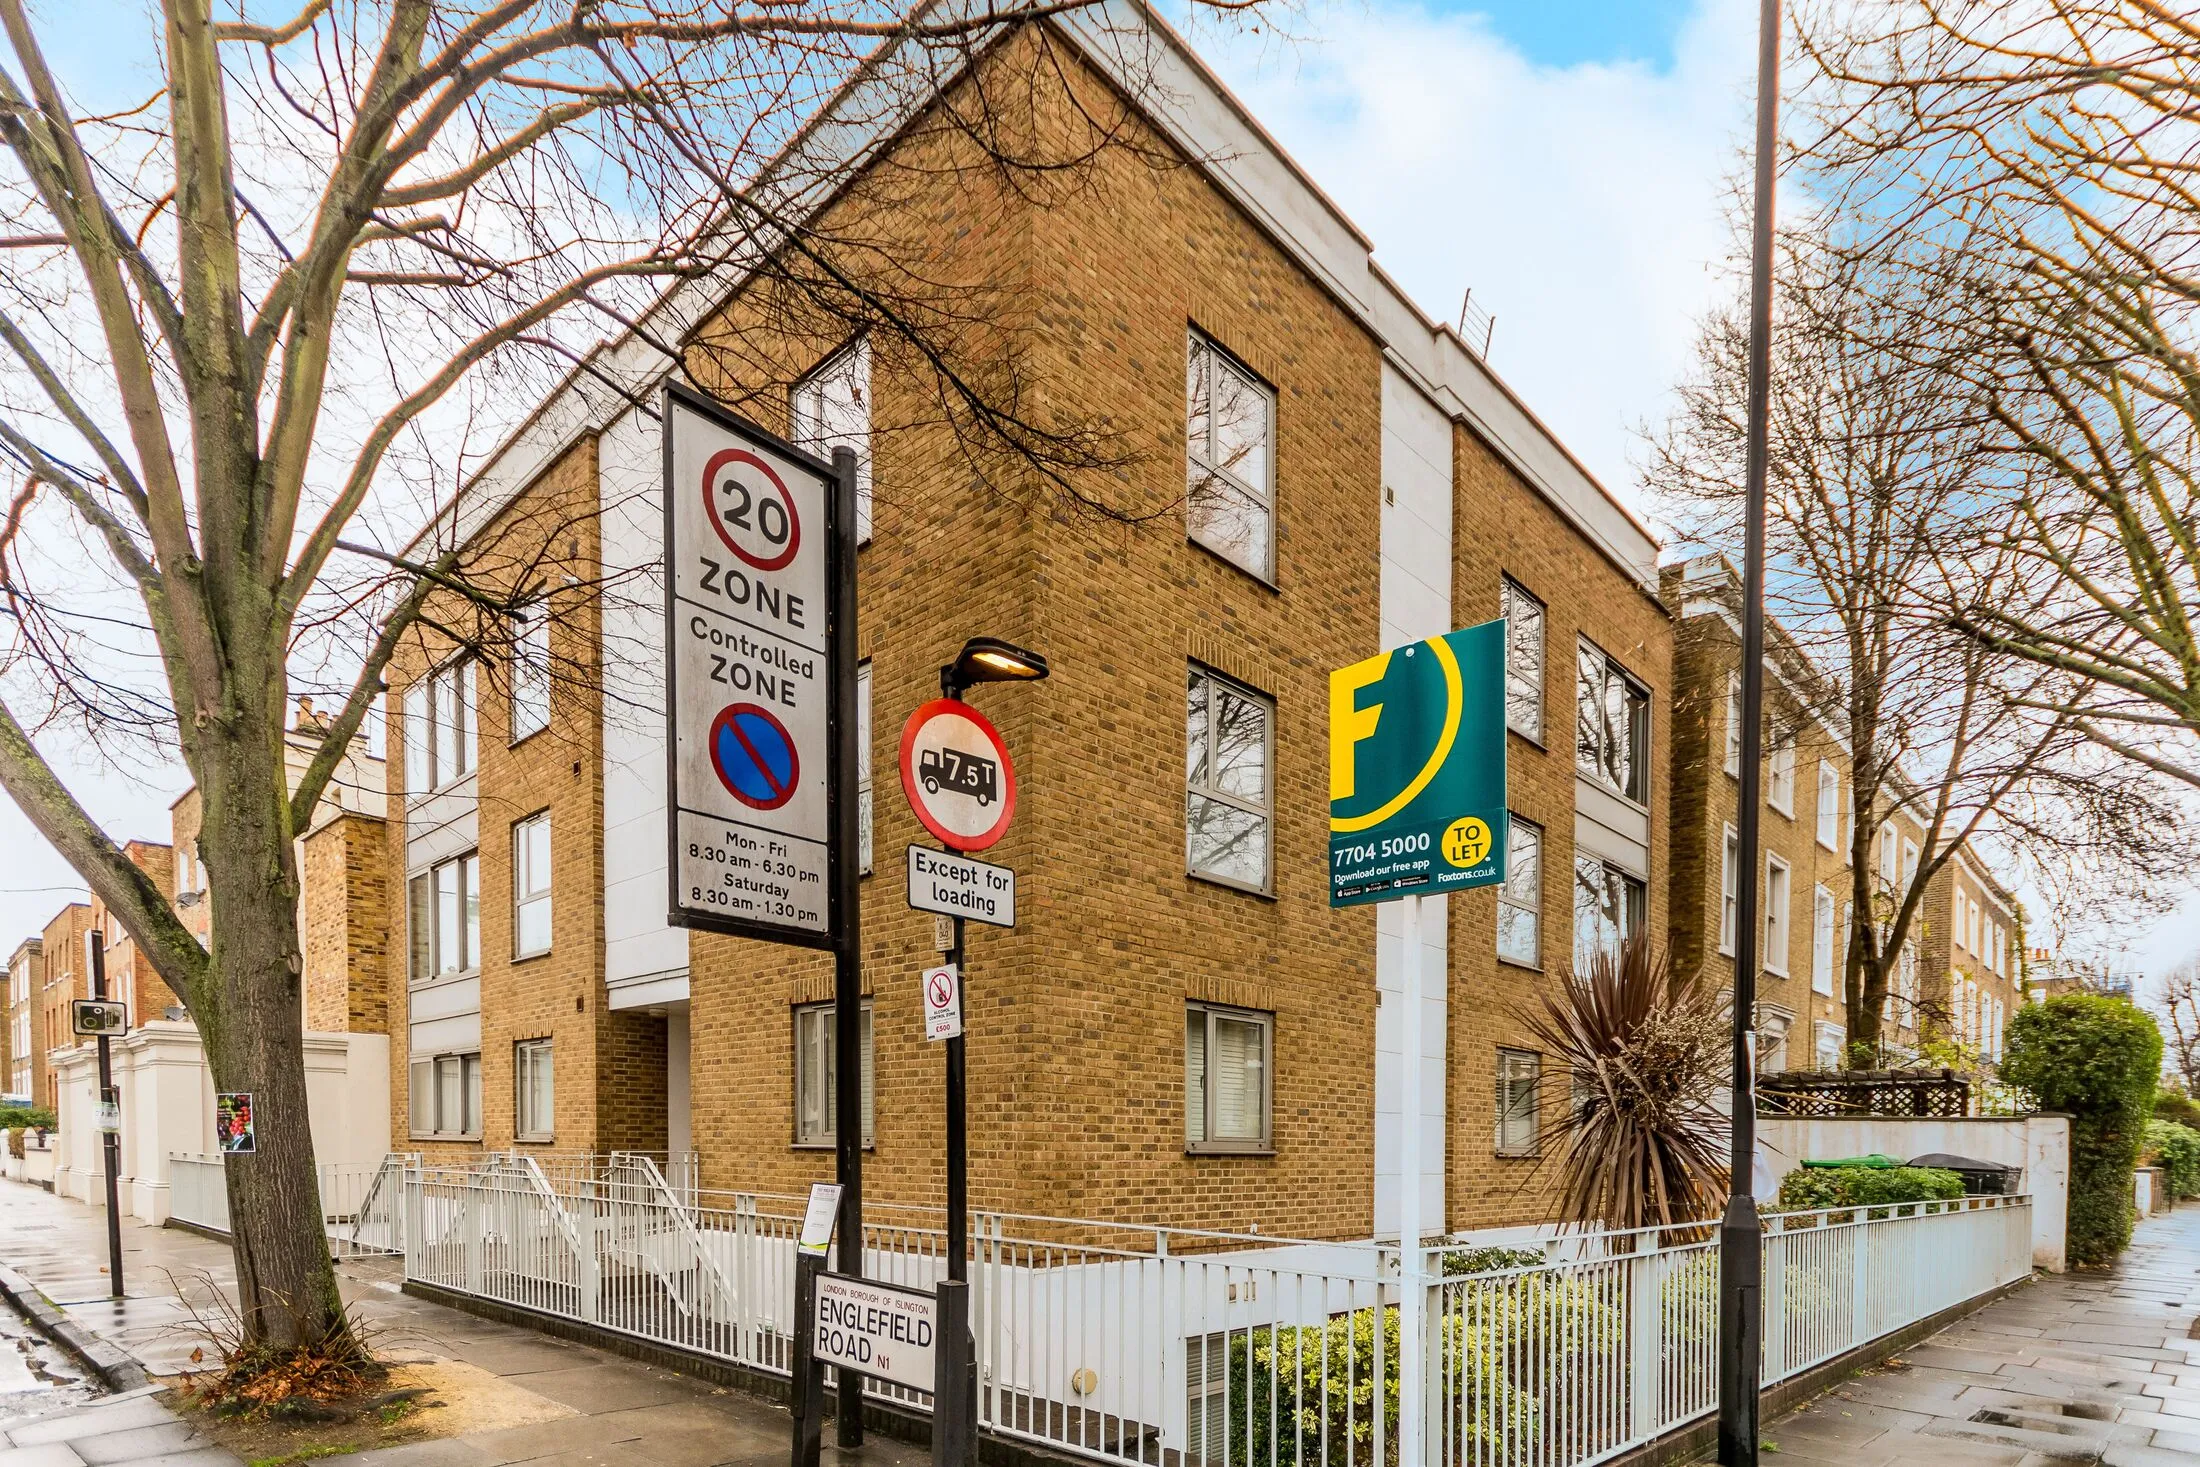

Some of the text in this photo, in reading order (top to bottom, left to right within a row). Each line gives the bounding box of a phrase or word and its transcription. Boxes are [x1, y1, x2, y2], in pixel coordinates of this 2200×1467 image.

[722, 479, 789, 545] 20
[700, 556, 805, 629] ZONE
[690, 616, 814, 680] Controlled
[710, 653, 797, 708] ZONE
[726, 831, 757, 851] Mon
[769, 841, 787, 857] Fri
[1334, 832, 1430, 867] 7704 5000
[1453, 825, 1480, 842] TO
[689, 843, 726, 863] 8.30
[730, 855, 751, 869] am
[763, 860, 796, 878] 6.30
[800, 870, 819, 883] pm
[1452, 842, 1483, 861] LET
[724, 873, 789, 900] Saturday
[916, 852, 1009, 891] Except for
[1334, 860, 1430, 883] Download our free app
[1438, 866, 1496, 882] Foxtons.co.uk
[692, 887, 728, 905] 8.30
[732, 897, 753, 910] am
[764, 901, 795, 917] 1.30
[798, 909, 818, 922] pm
[932, 882, 996, 916] loading
[936, 1024, 950, 1032] £500
[823, 1283, 929, 1315] LONDON BOROUGH OF ISLINGTON
[820, 1296, 932, 1348] ENGLEFIELD
[819, 1325, 890, 1370] ROAD N1
